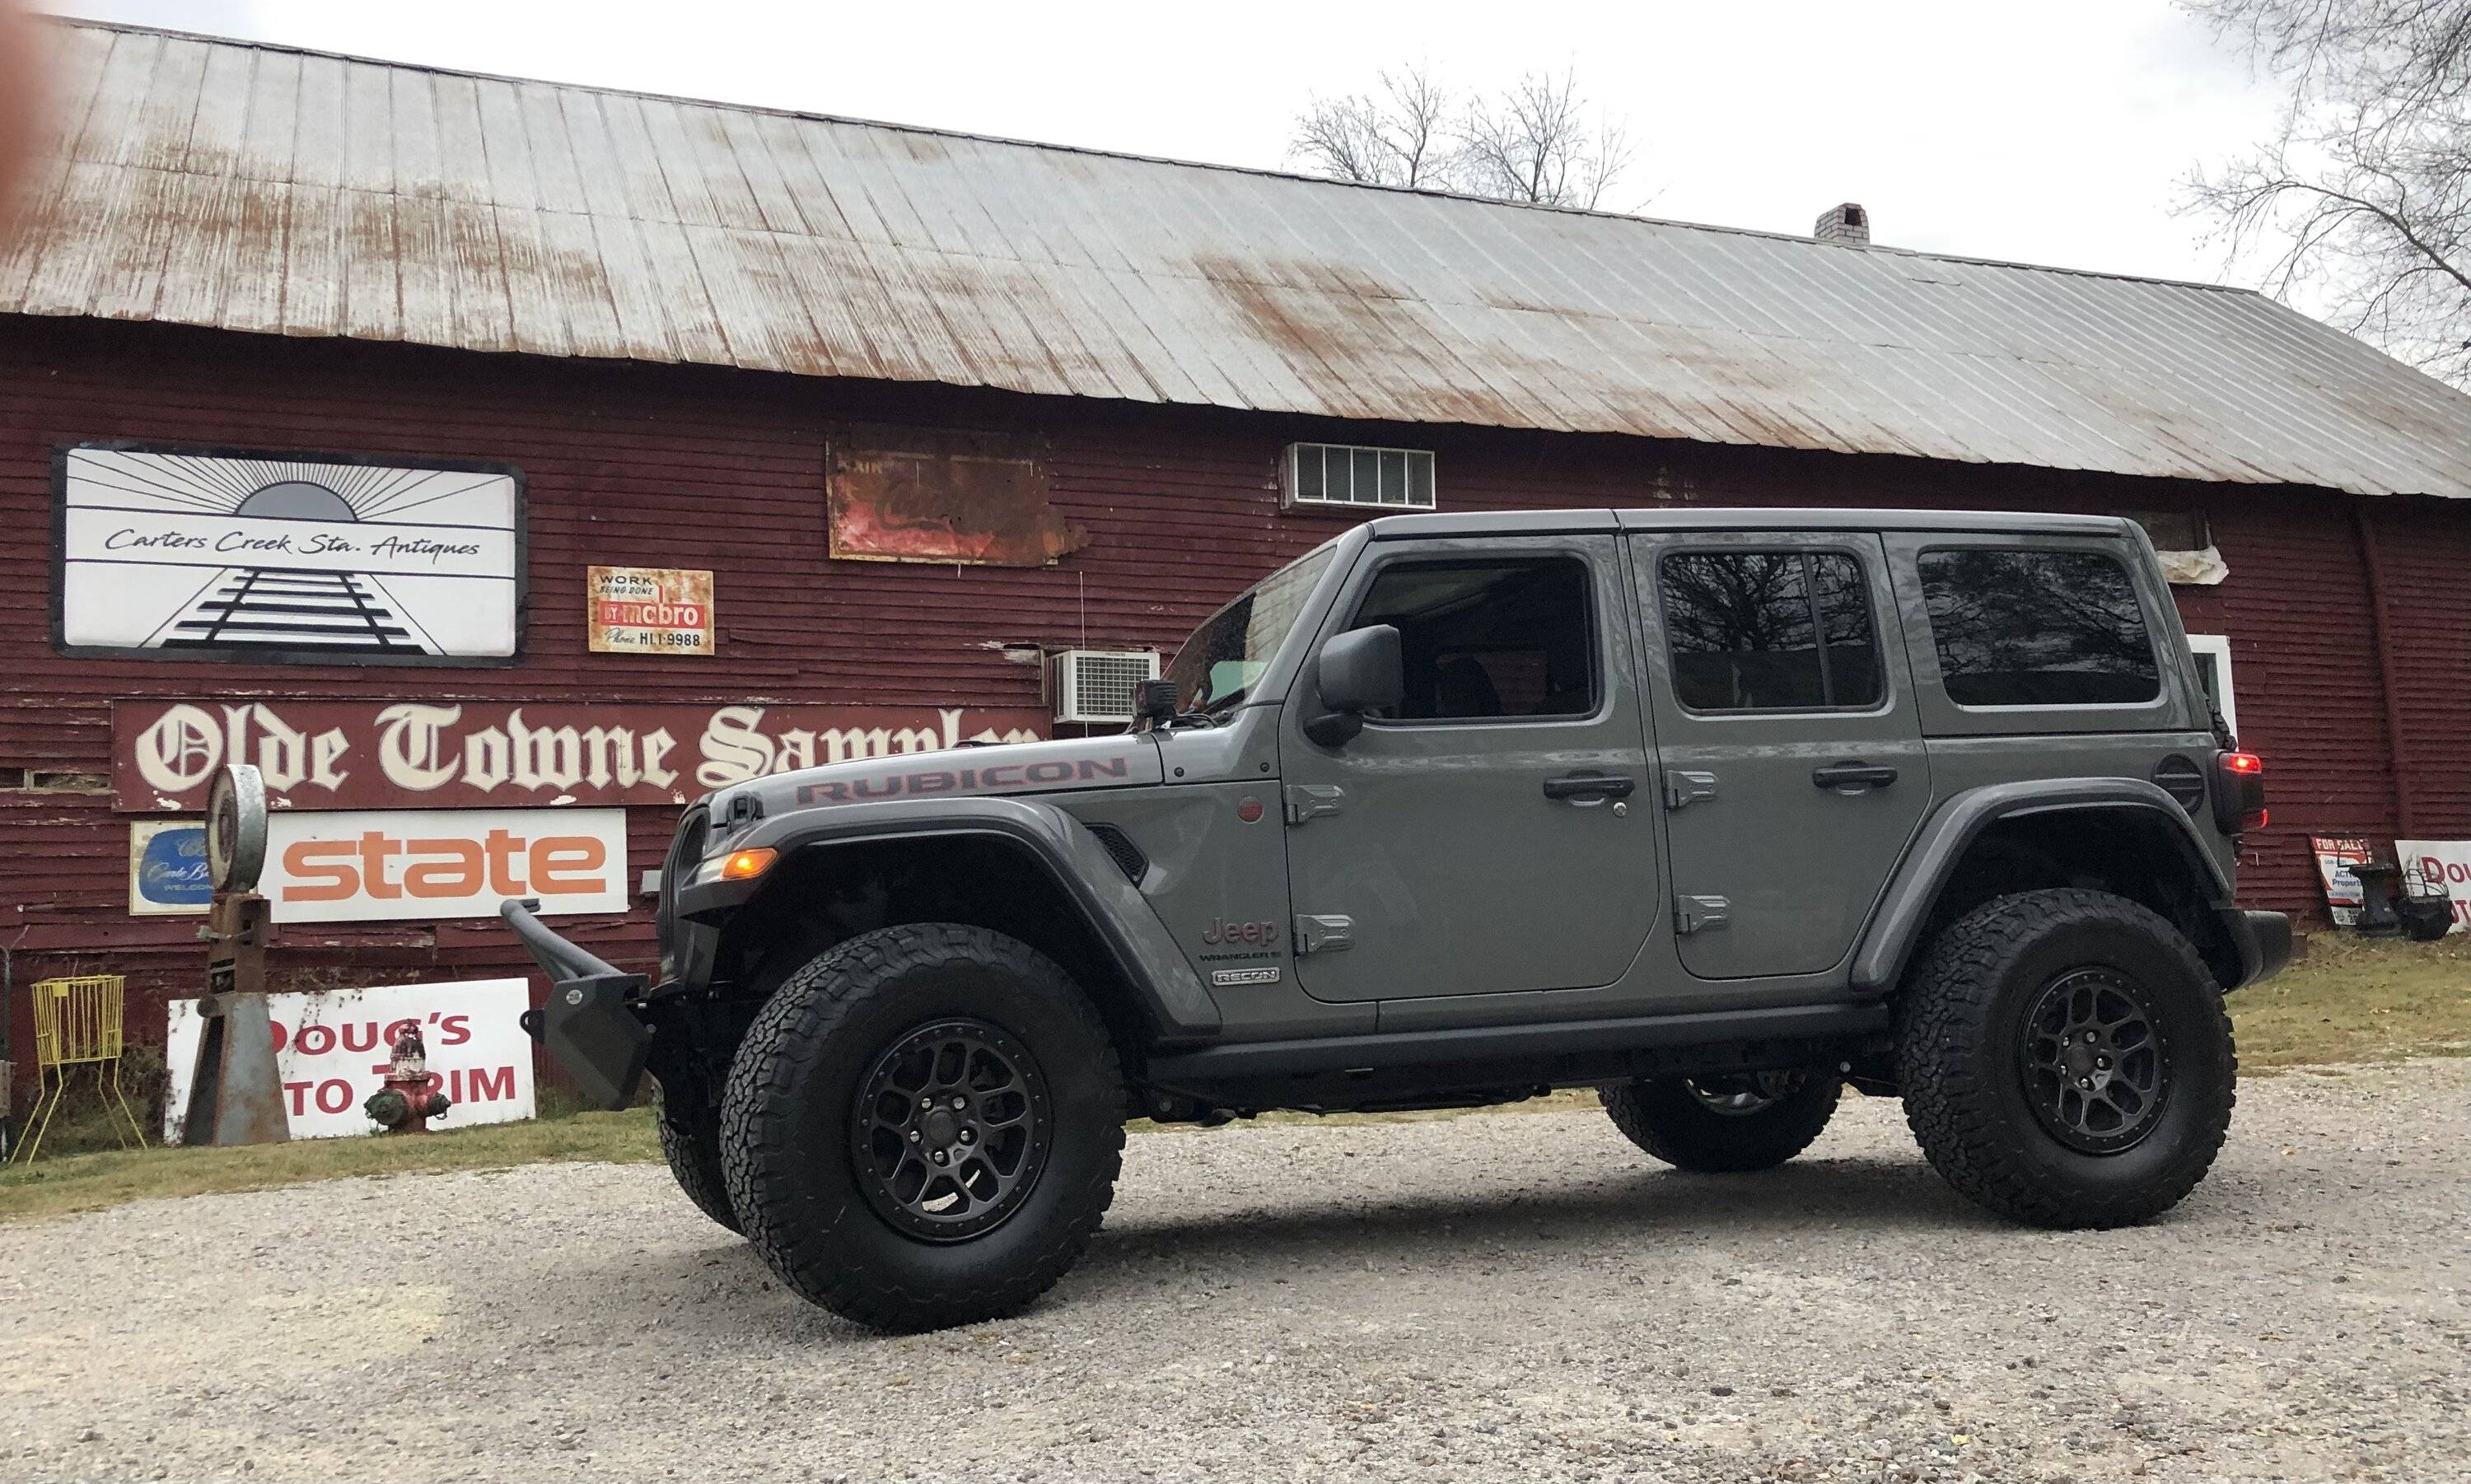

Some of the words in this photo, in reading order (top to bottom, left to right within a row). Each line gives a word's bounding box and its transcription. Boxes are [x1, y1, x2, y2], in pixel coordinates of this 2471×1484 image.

[105, 529, 208, 551] Carters
[214, 530, 293, 554] Creek
[298, 534, 361, 555] Sta.
[371, 534, 479, 564] Antiques
[600, 575, 652, 585] WORK
[600, 586, 626, 594] BEING
[628, 586, 653, 595] DONE
[605, 627, 636, 643] Phone
[135, 702, 350, 793] Olde
[374, 703, 679, 791] Towne
[795, 757, 1128, 805] RUBICON
[2315, 838, 2335, 850] FOR
[283, 828, 606, 903] state
[1203, 917, 1279, 946] Jeep
[1199, 952, 1268, 961] WRANGLER
[1217, 971, 1276, 982] RECON
